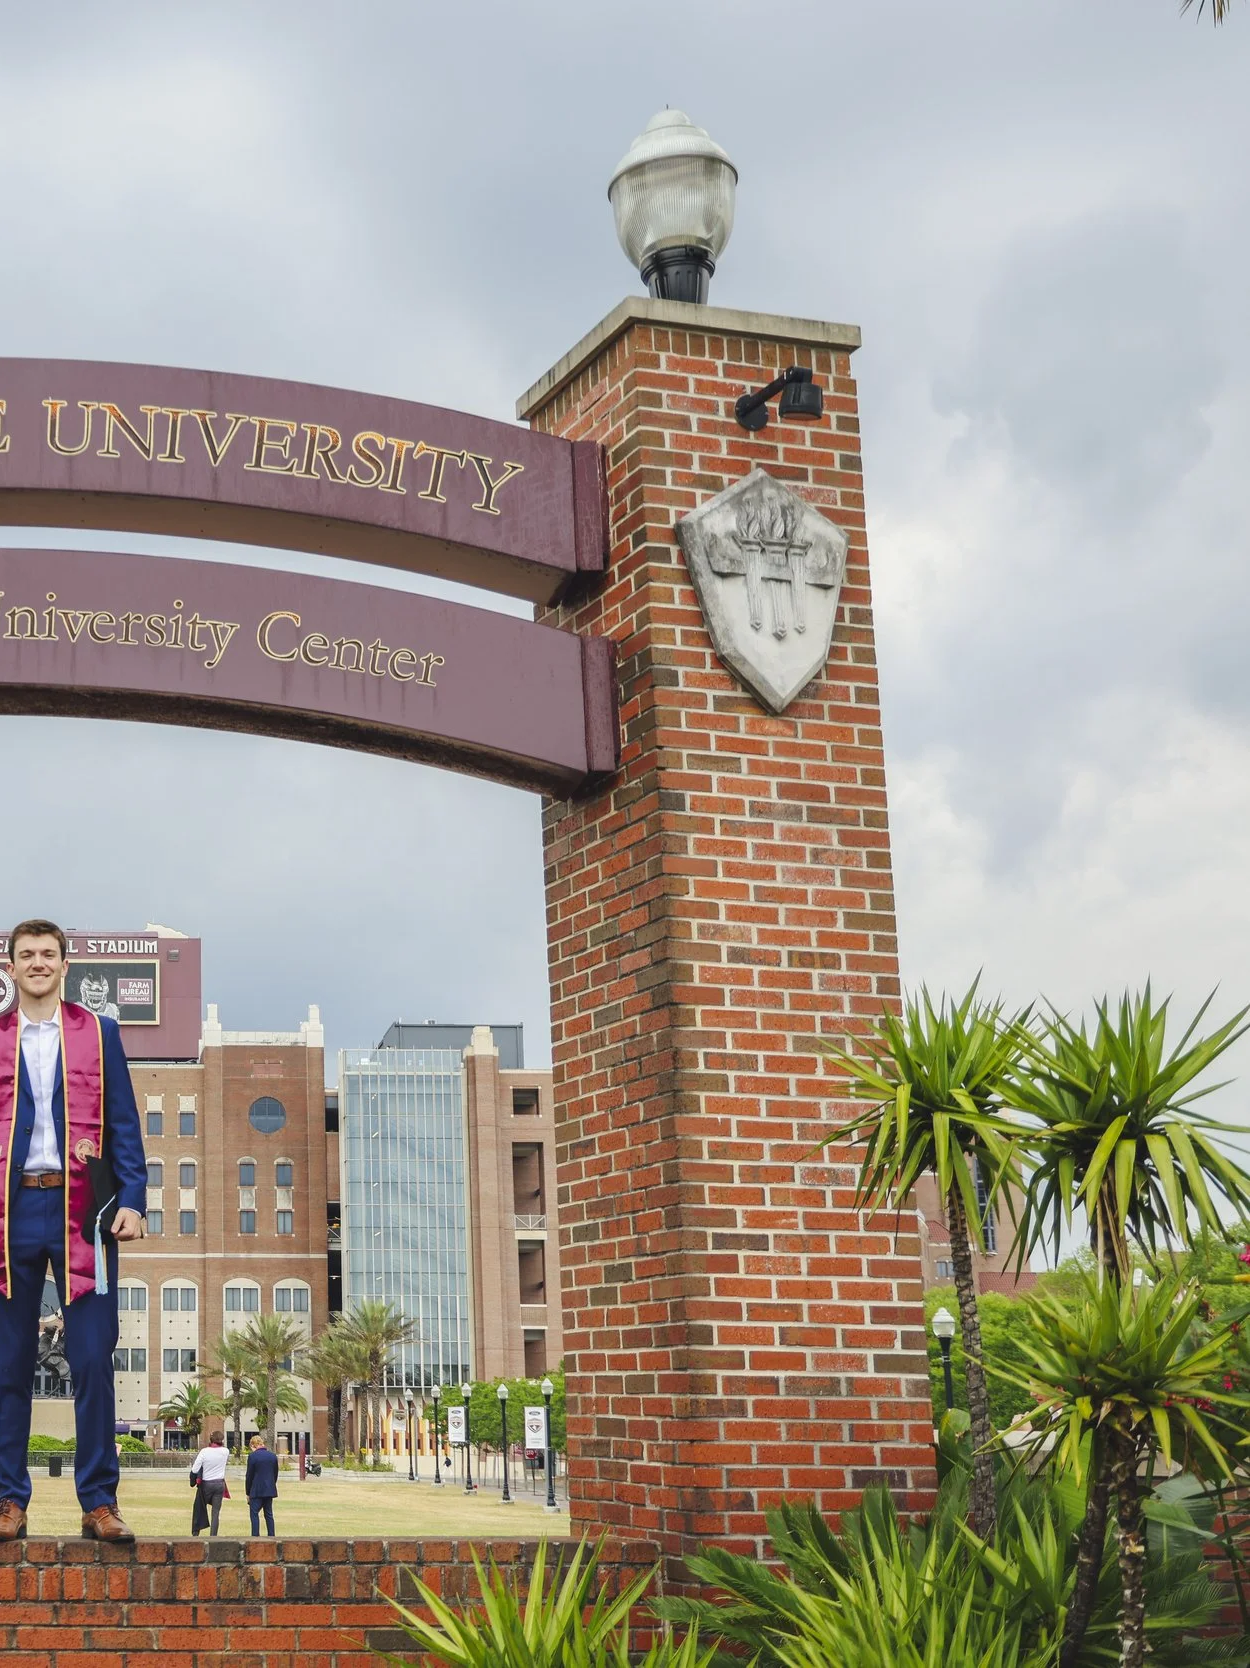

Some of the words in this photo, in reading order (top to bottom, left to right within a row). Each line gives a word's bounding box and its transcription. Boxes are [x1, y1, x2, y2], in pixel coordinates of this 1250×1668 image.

[42, 396, 525, 516] UNIVERSITY
[256, 611, 446, 688] Center
[87, 939, 159, 954] STADIUM
[128, 981, 150, 989] FARM
